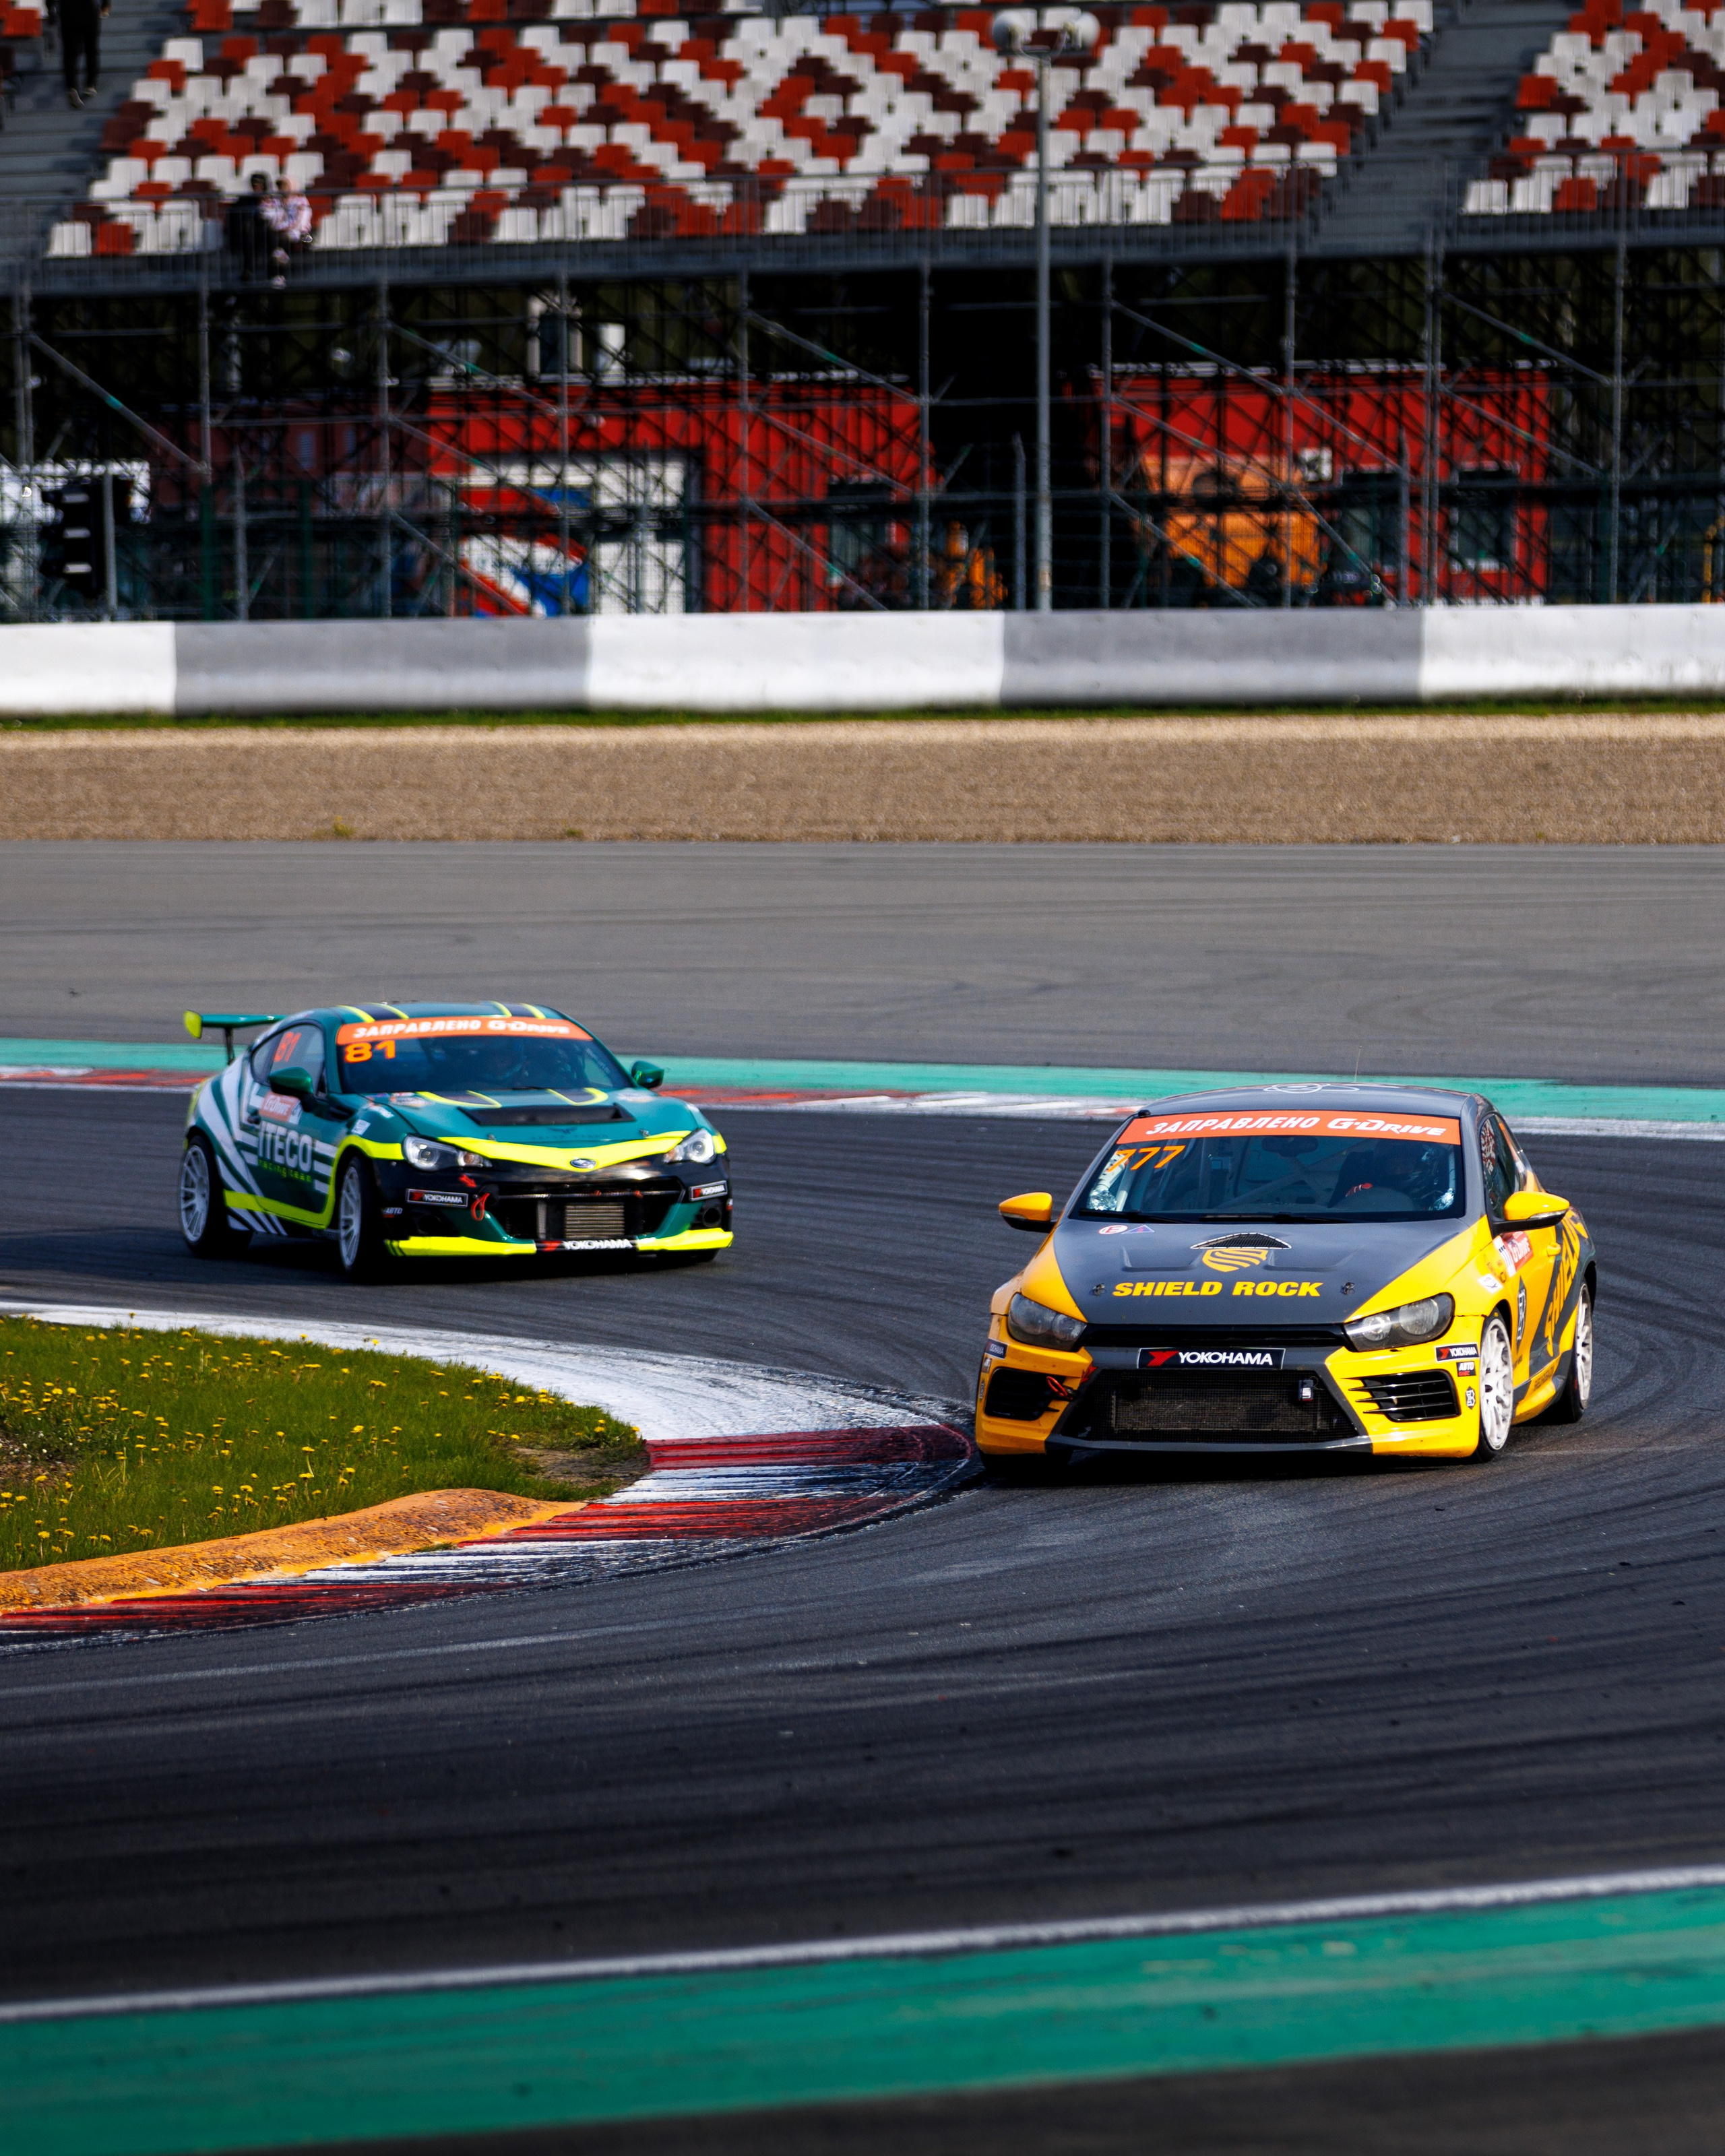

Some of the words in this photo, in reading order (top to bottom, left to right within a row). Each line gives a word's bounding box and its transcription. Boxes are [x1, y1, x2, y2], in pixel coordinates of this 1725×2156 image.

[353, 1019, 481, 1038] ЗАПРАВЛЕНО
[274, 1032, 301, 1063] 81
[344, 1040, 396, 1063] 81
[1146, 1117, 1321, 1135] ЗАПРАВЛЕНО
[259, 1120, 313, 1172] ITECO
[1106, 1145, 1186, 1173] 777
[423, 1194, 463, 1203] YOKOHAMA
[562, 1239, 633, 1250] YOKOHAMA
[1112, 1281, 1222, 1296] SHIELD
[1232, 1281, 1323, 1296] ROCK
[1179, 1352, 1273, 1365] YOKOHAMA
[1449, 1347, 1477, 1357] YOKOHAMA
